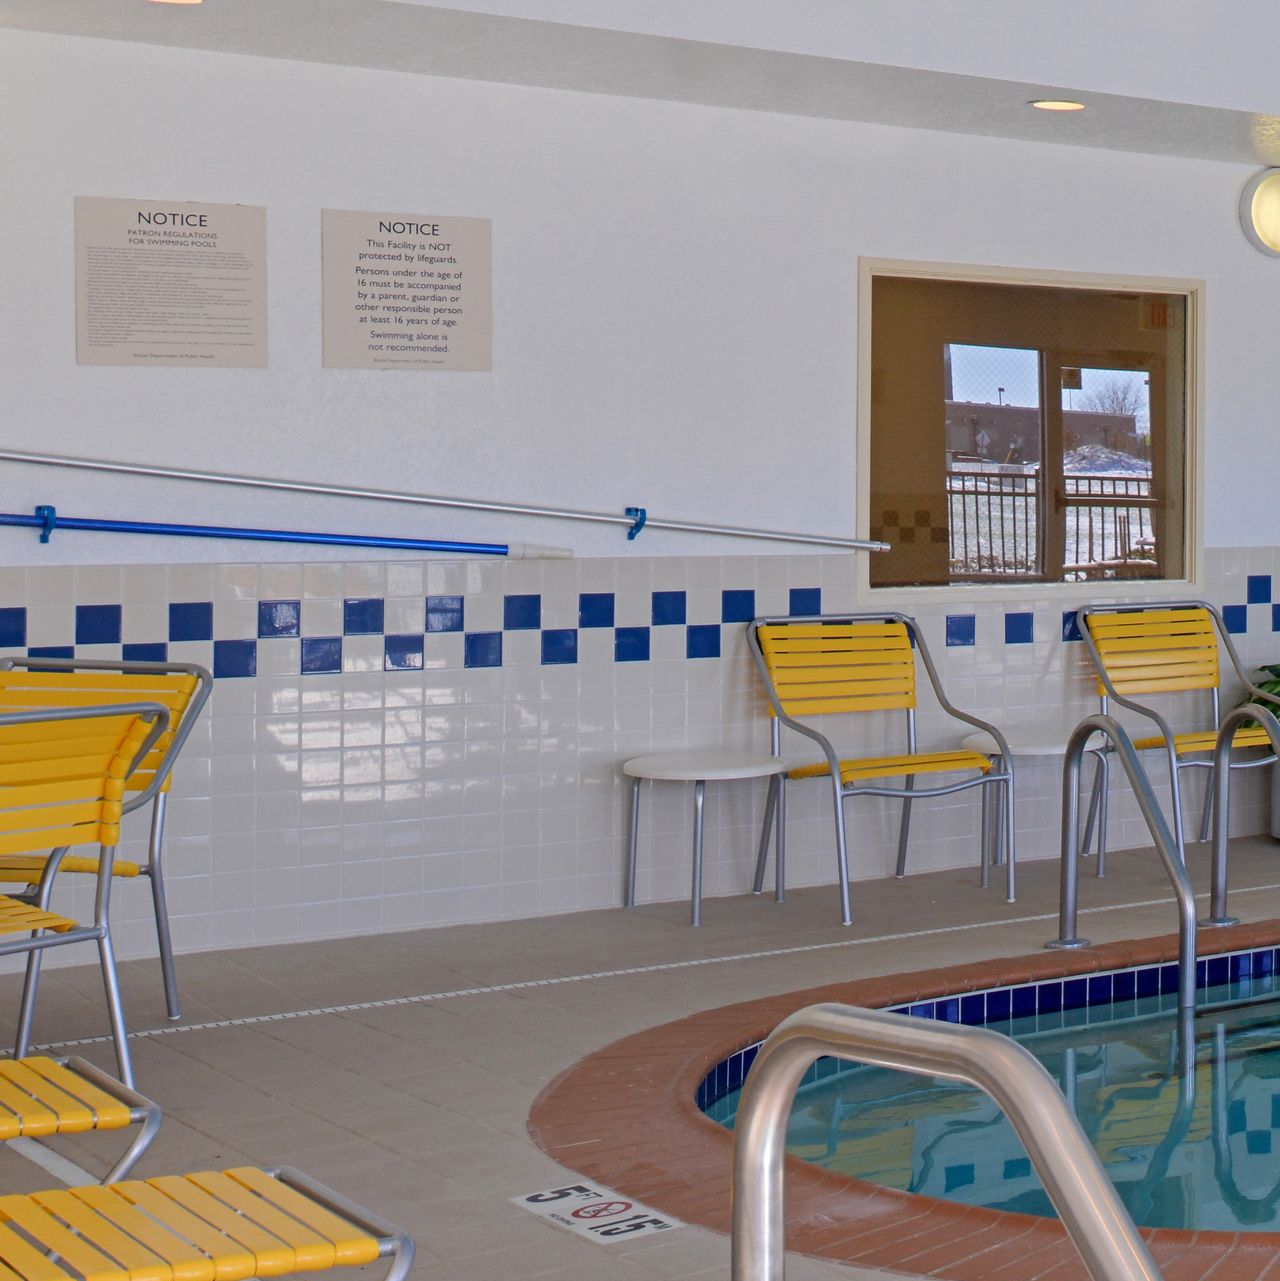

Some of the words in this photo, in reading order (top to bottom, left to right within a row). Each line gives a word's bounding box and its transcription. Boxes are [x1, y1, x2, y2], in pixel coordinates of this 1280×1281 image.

[138, 212, 207, 227] NOTICE
[380, 222, 439, 235] NOTICE
[164, 231, 217, 239] REGULATIONS
[367, 239, 384, 248] This
[388, 240, 416, 251] Facility
[420, 241, 426, 250] is
[429, 242, 451, 251] NOT
[359, 253, 401, 262] protected
[405, 254, 414, 263] by
[356, 267, 389, 276] Persons
[393, 269, 417, 277] under
[421, 270, 434, 278] the
[437, 272, 451, 280] age
[358, 279, 366, 287] 16
[394, 280, 404, 288] be
[408, 283, 461, 291] accompanied
[358, 291, 367, 300] by
[412, 294, 447, 302] guardian
[355, 303, 379, 311] other
[383, 305, 430, 314] responsible
[434, 307, 462, 315] person
[406, 318, 428, 326] years
[432, 317, 440, 325] of
[370, 331, 413, 341] Swimming
[442, 333, 448, 341] is
[526, 1185, 591, 1203] 5
